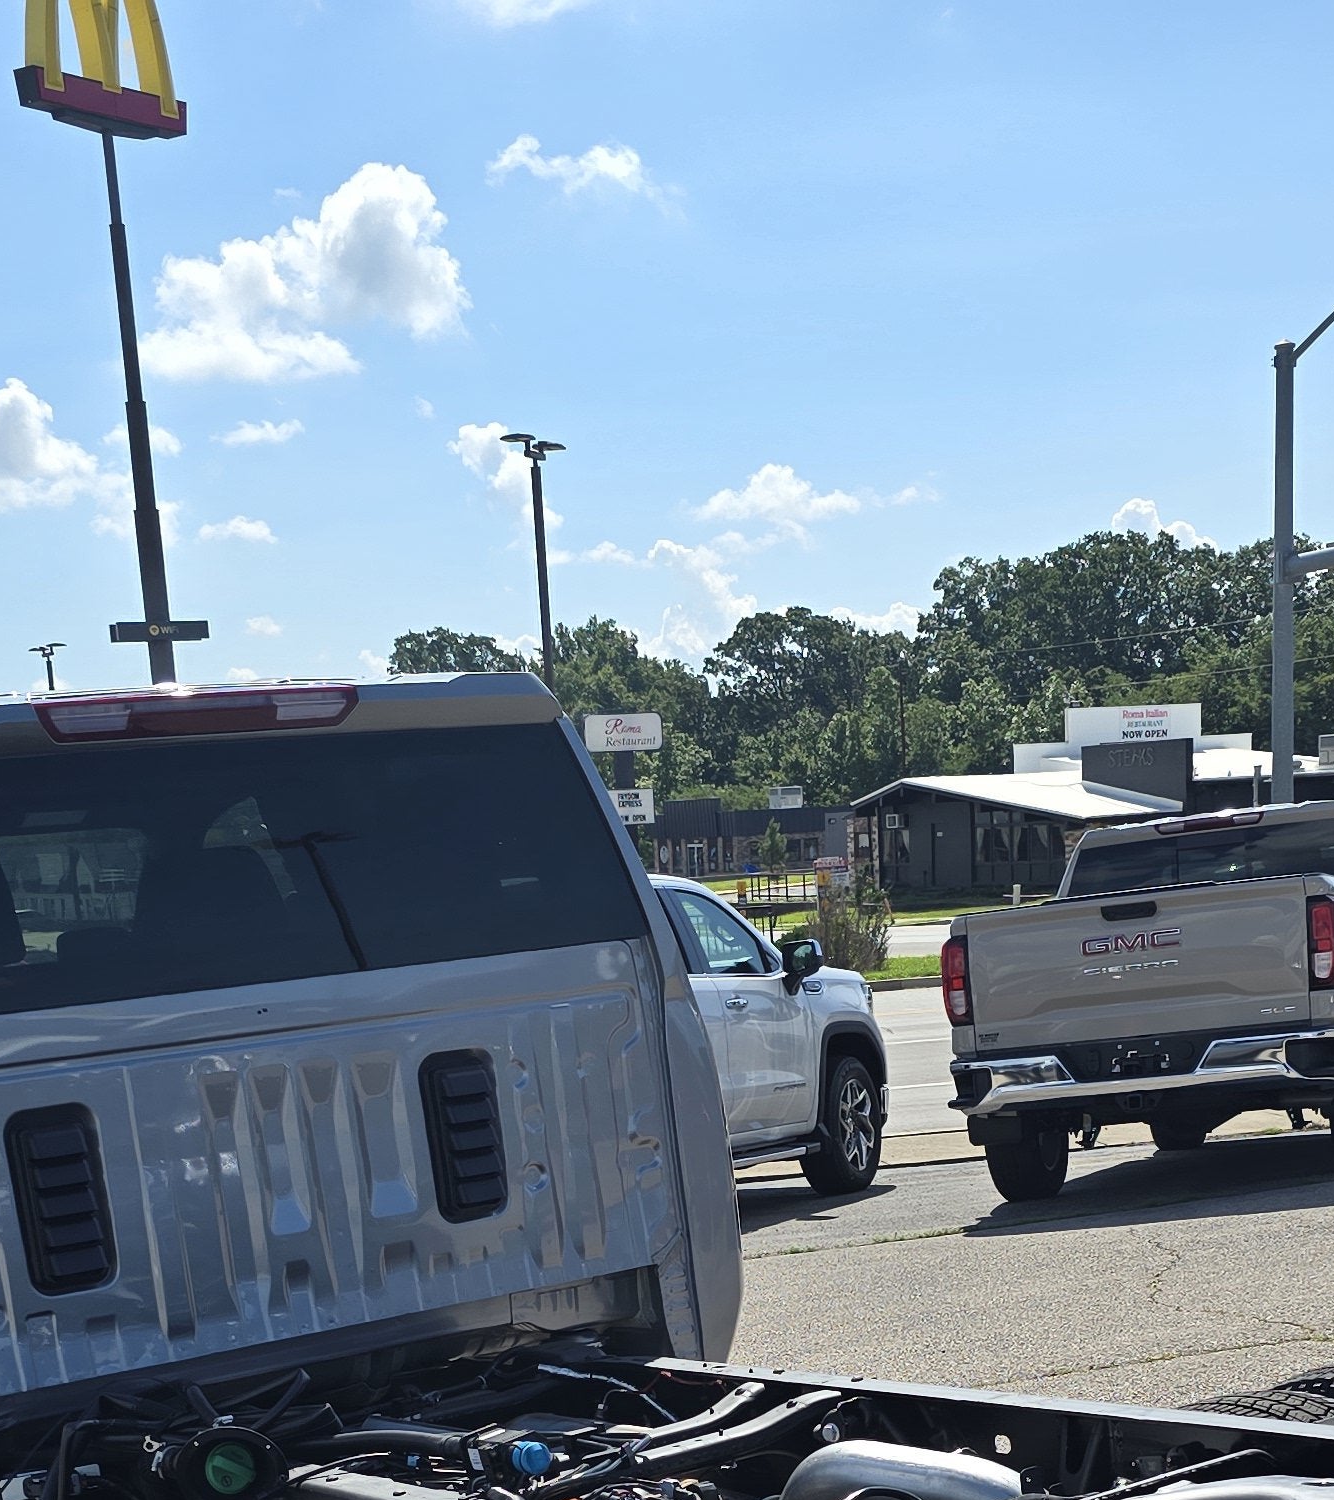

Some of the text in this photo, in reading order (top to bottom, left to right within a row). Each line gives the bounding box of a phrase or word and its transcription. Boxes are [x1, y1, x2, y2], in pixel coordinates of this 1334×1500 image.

[1122, 708, 1169, 719] Roma Italian
[1122, 729, 1168, 739] NOW OPEN
[605, 735, 656, 747] Restaurant
[632, 814, 646, 822] OPEN
[1080, 928, 1181, 956] GMC
